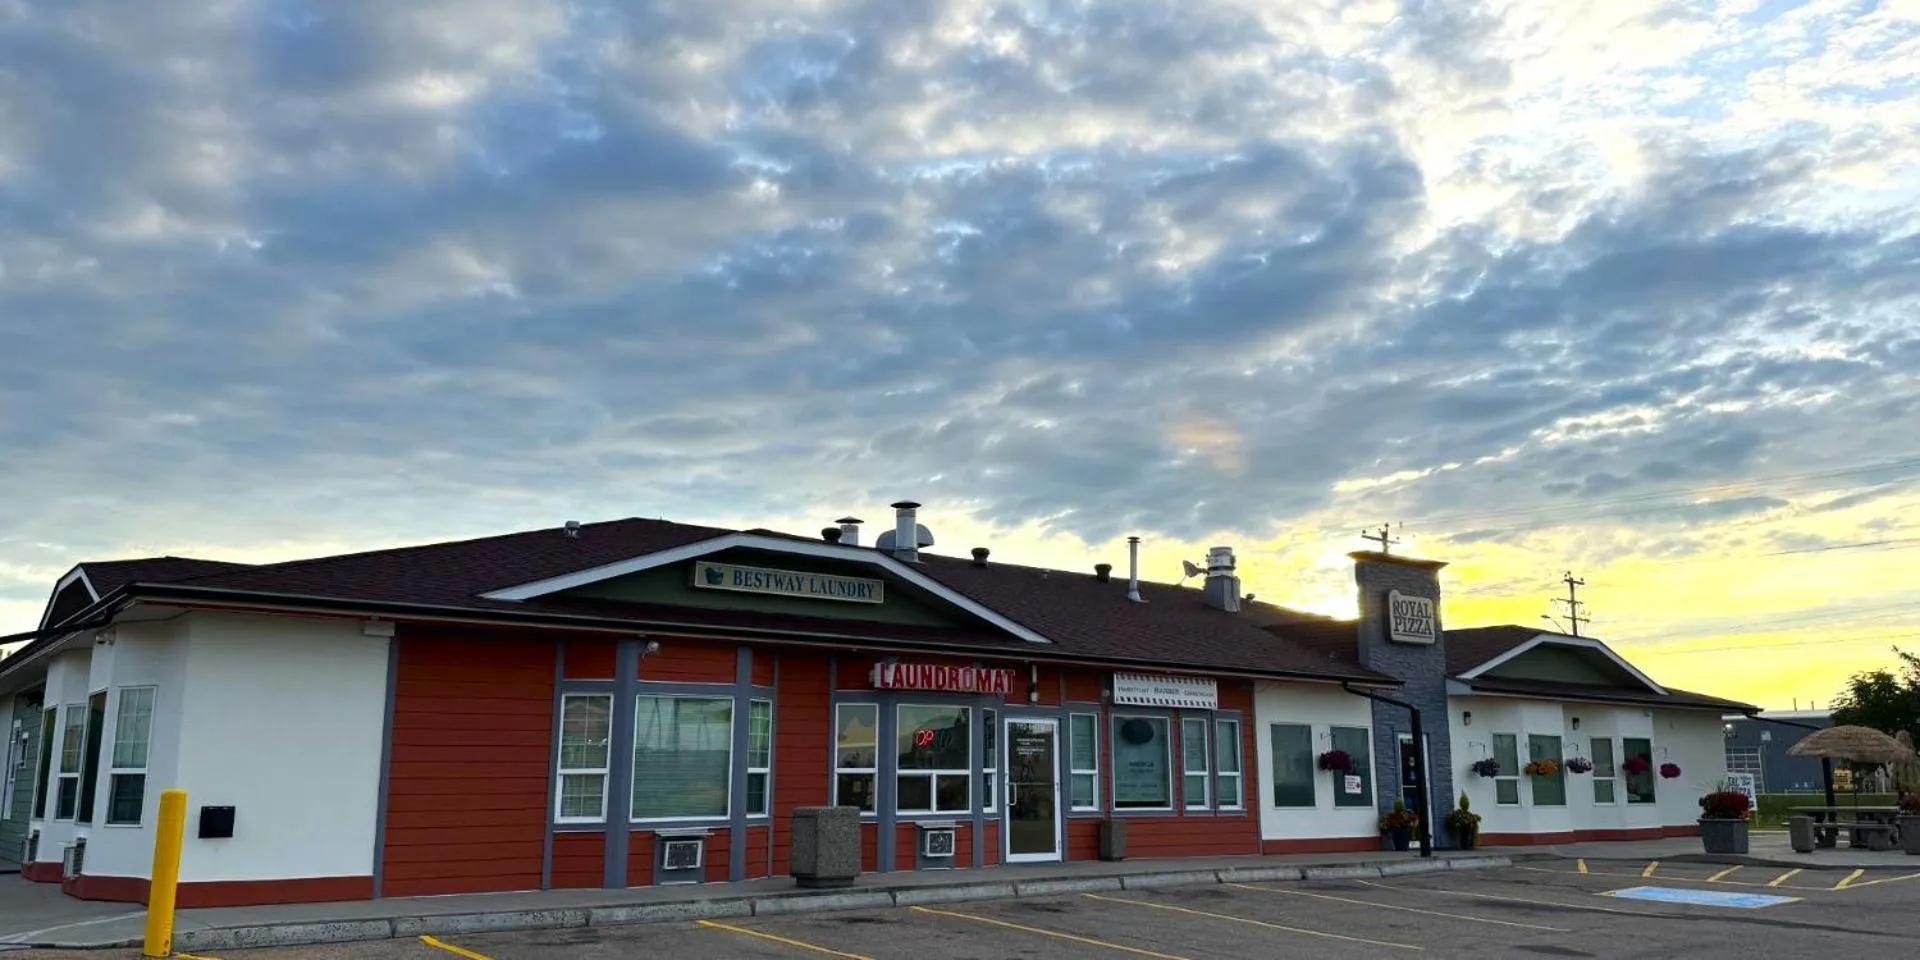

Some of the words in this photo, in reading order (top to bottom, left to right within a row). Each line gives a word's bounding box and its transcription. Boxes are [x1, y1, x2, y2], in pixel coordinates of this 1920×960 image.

[733, 569, 804, 593] BESTWAY
[810, 578, 874, 599] LAUNDRY
[1393, 600, 1432, 618] ROYAL
[1394, 617, 1433, 635] PIZZA
[880, 663, 1015, 693] LAUNDROMAT
